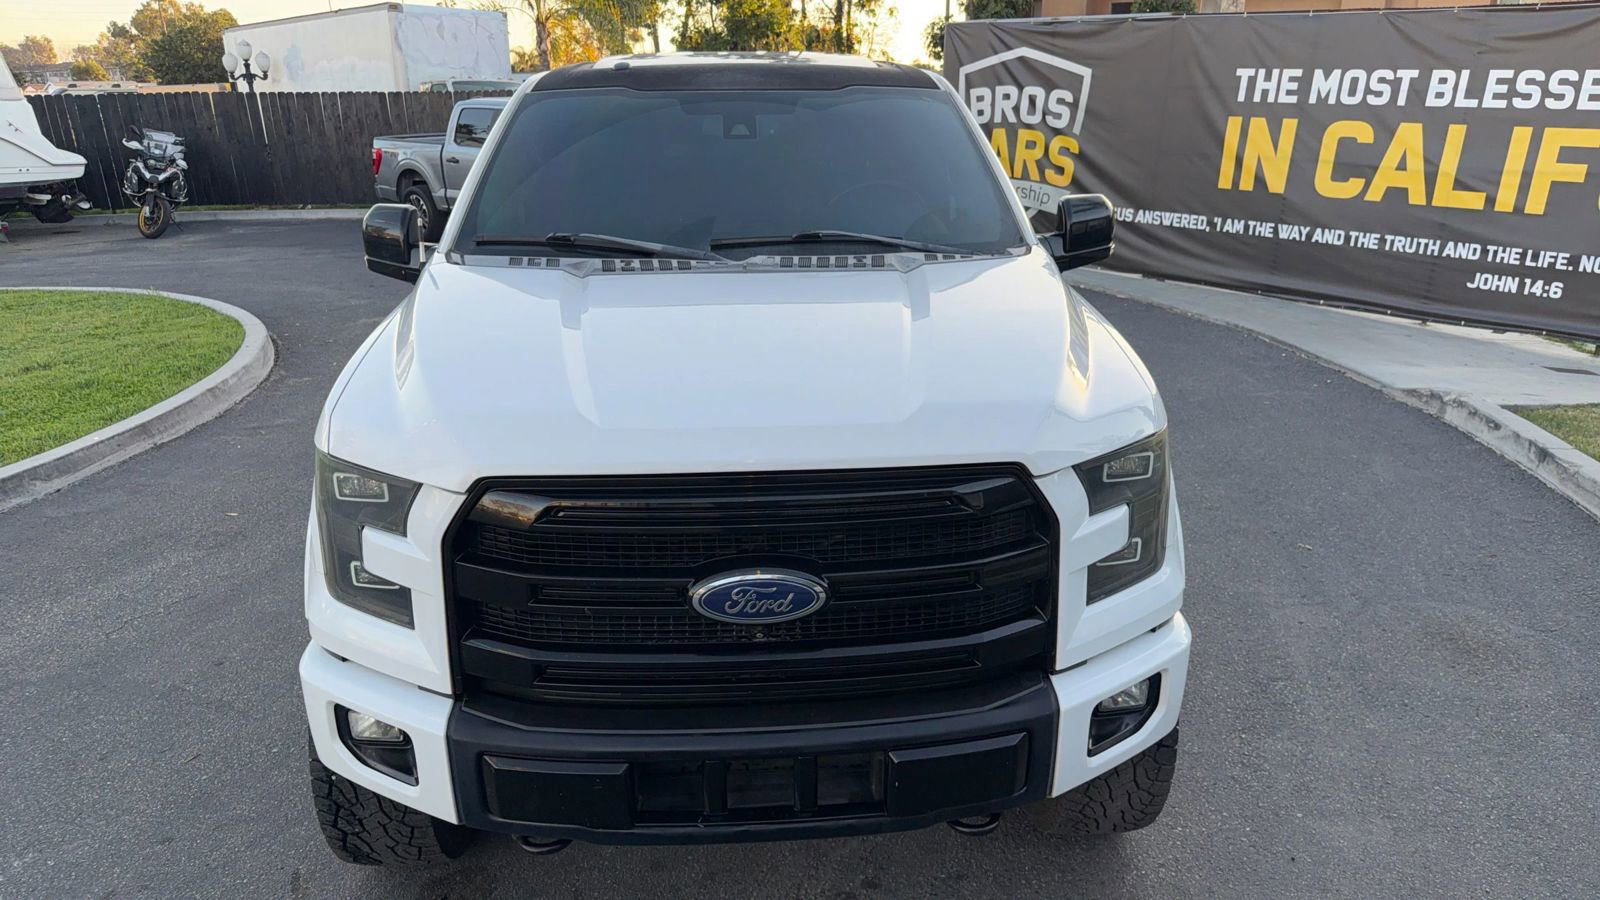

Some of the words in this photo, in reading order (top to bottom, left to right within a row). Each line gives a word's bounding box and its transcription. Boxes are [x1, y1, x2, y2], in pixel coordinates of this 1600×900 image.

[969, 85, 1074, 129] BROS
[1235, 68, 1303, 104] THE
[1308, 68, 1419, 107] MOST
[990, 127, 1079, 188] ARS
[1217, 115, 1299, 194] IN
[1314, 120, 1600, 215] CALIF
[1015, 184, 1050, 207] rship
[1114, 207, 1134, 222] US
[1135, 209, 1210, 232] ANSWERED,
[1223, 218, 1245, 234] AM
[1247, 220, 1275, 238] THE
[1277, 224, 1310, 242] WAY
[1311, 227, 1345, 246] AND
[1349, 231, 1381, 250] THE
[1384, 234, 1441, 256] TRUTH
[1442, 240, 1482, 261] AND
[1486, 245, 1523, 265] THE
[1525, 249, 1574, 271] LIFE.
[1466, 272, 1519, 294] JOHN
[1523, 277, 1564, 299] 14:6
[724, 586, 795, 614] Ford
